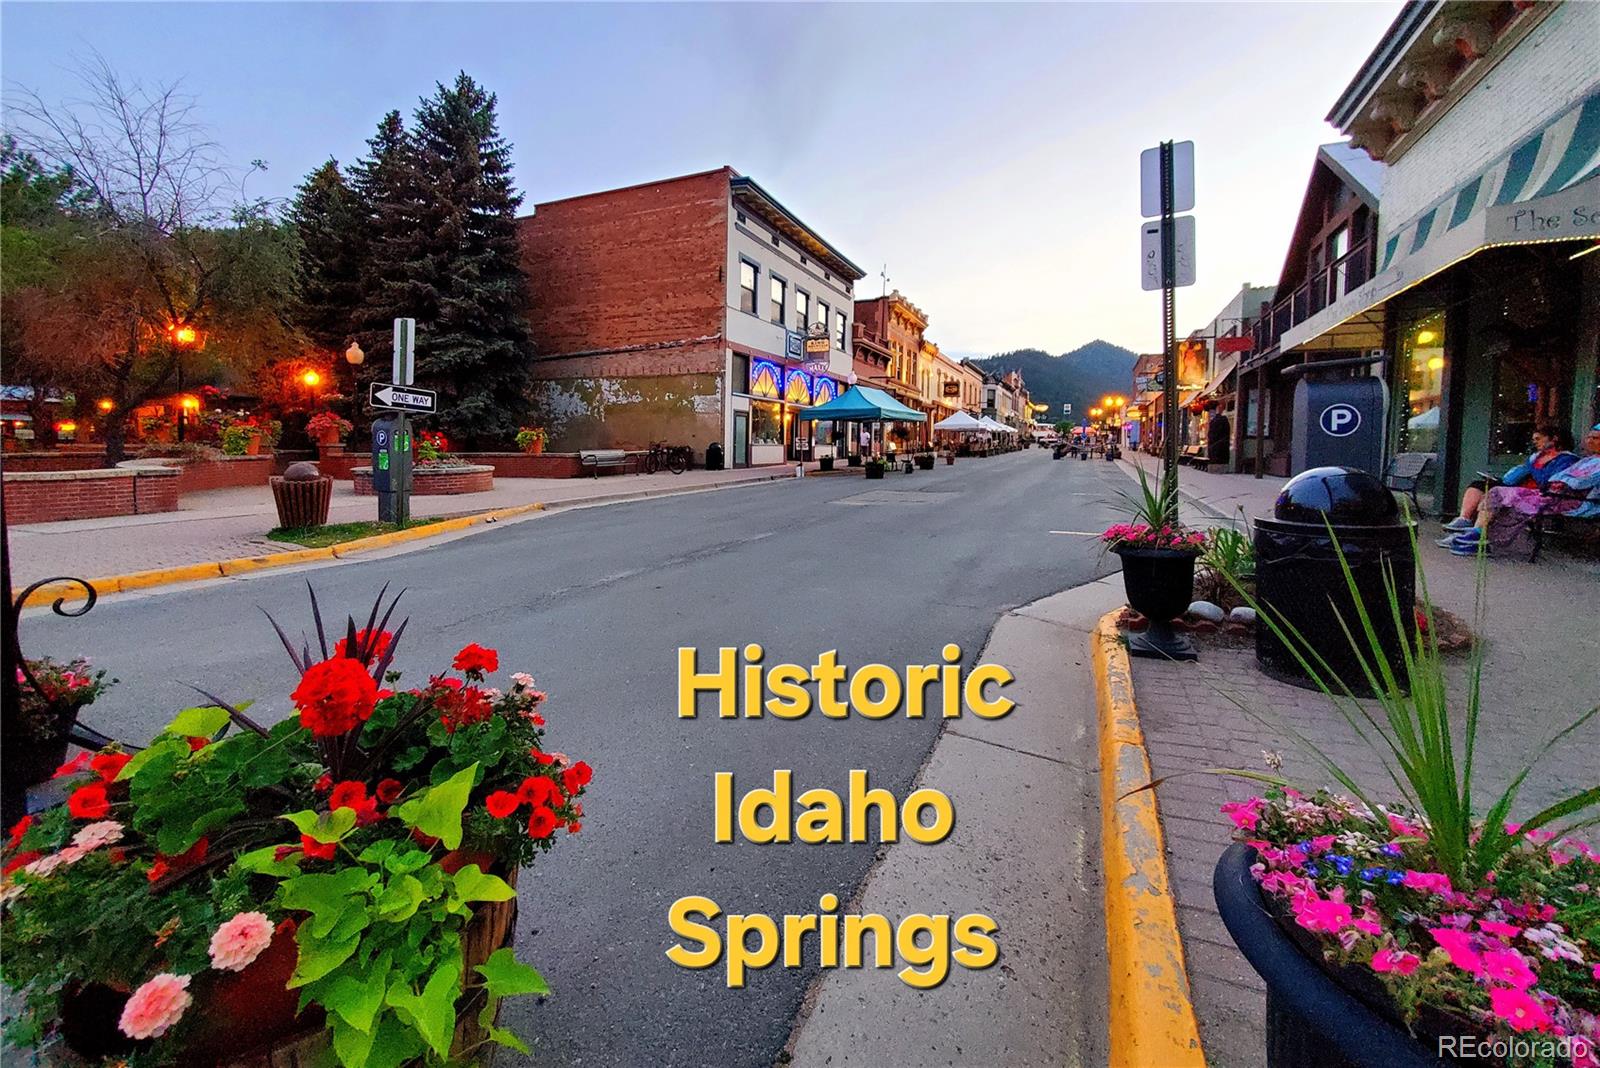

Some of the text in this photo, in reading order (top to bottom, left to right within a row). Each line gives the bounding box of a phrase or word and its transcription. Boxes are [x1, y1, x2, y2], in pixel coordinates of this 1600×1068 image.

[1507, 208, 1560, 231] The
[392, 392, 430, 405] ONE WAY
[1332, 409, 1352, 431] P
